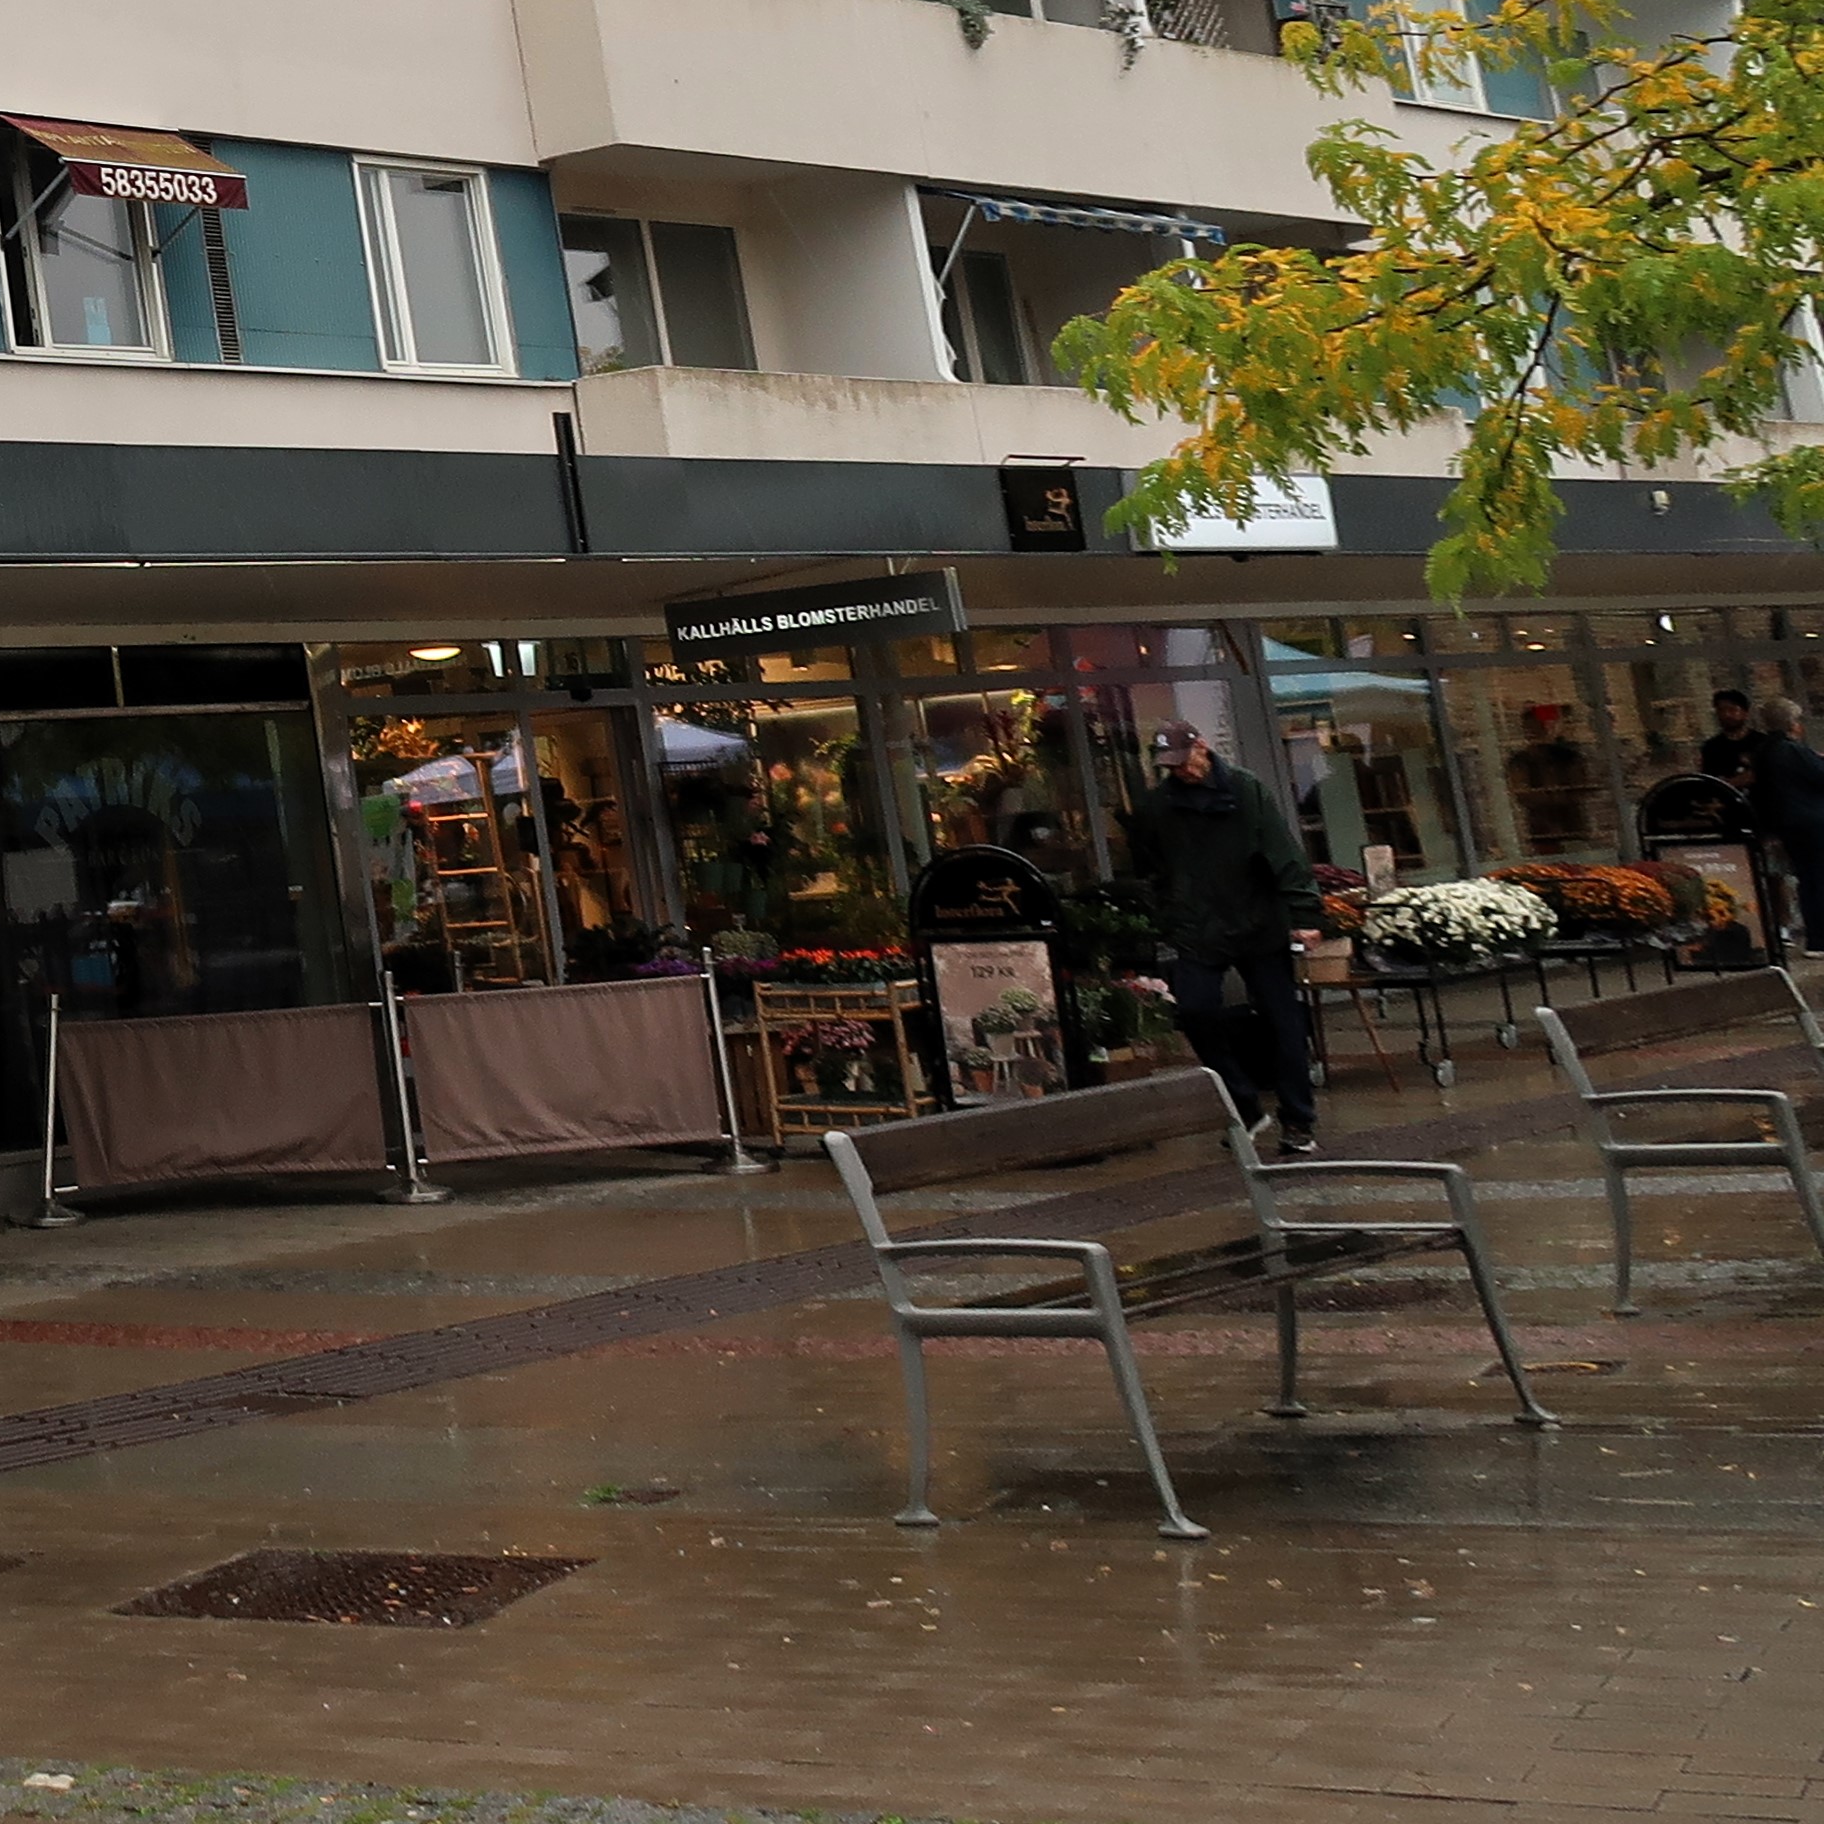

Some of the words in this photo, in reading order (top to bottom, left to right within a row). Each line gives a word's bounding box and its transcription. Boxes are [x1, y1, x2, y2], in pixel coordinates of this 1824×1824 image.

[101, 166, 218, 205] 58355033
[677, 616, 773, 641] KALLHÄLLS
[777, 597, 942, 629] BLOMSTERHANDEL
